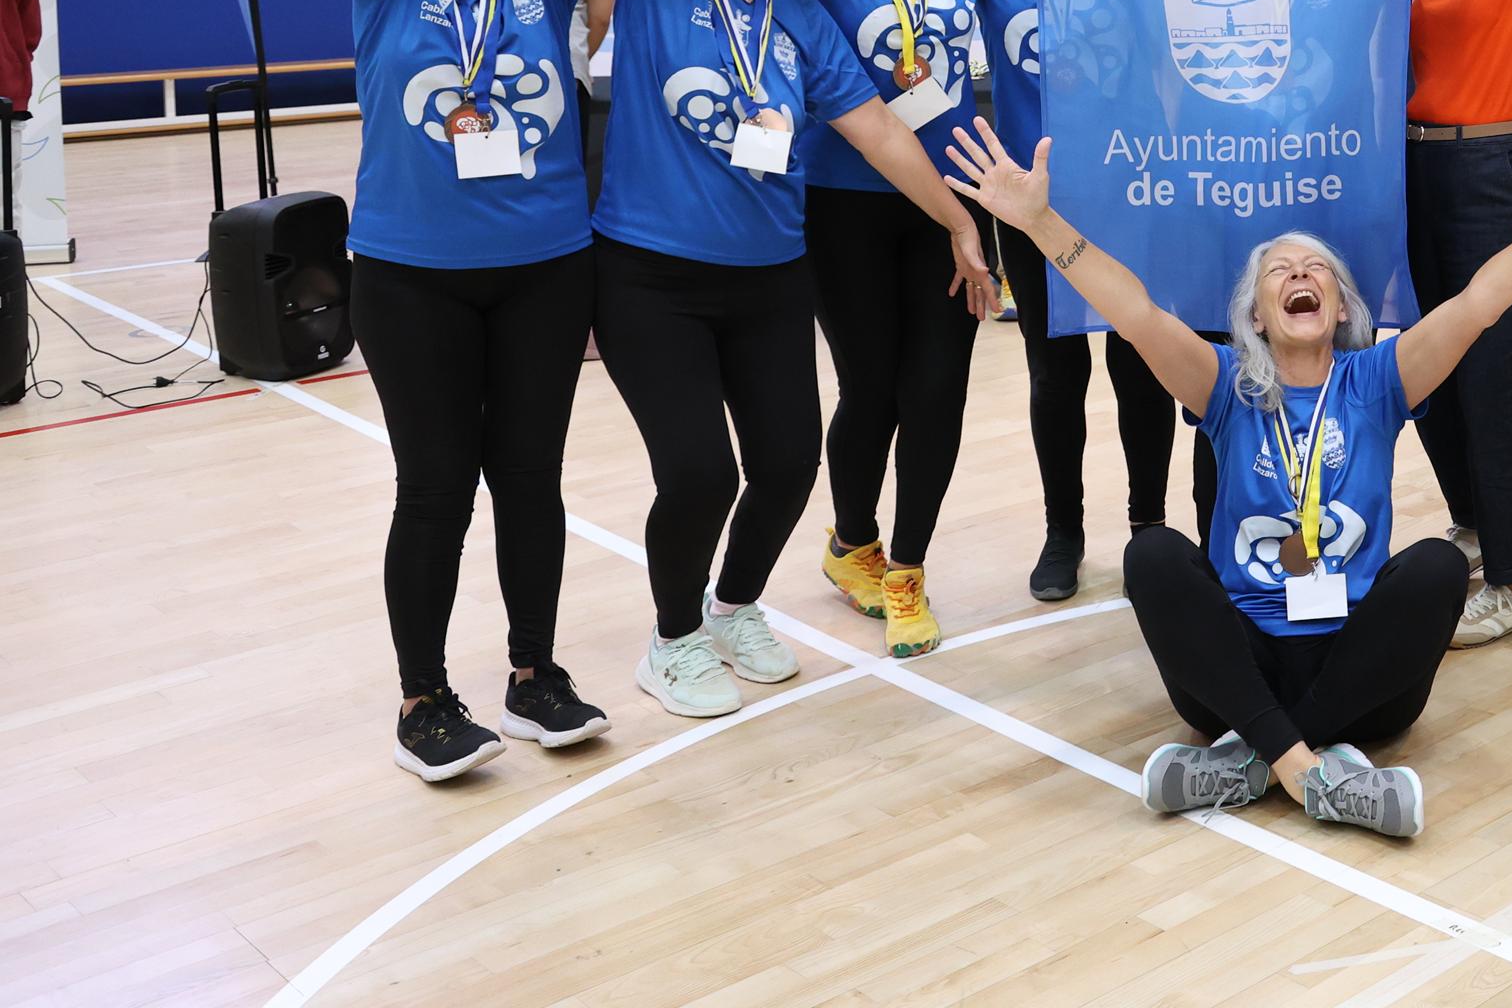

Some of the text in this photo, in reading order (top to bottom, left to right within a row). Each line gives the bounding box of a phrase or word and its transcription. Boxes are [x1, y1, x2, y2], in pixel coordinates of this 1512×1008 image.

[1103, 123, 1362, 172] Ayuntamiento
[1126, 171, 1343, 218] de Teguise
